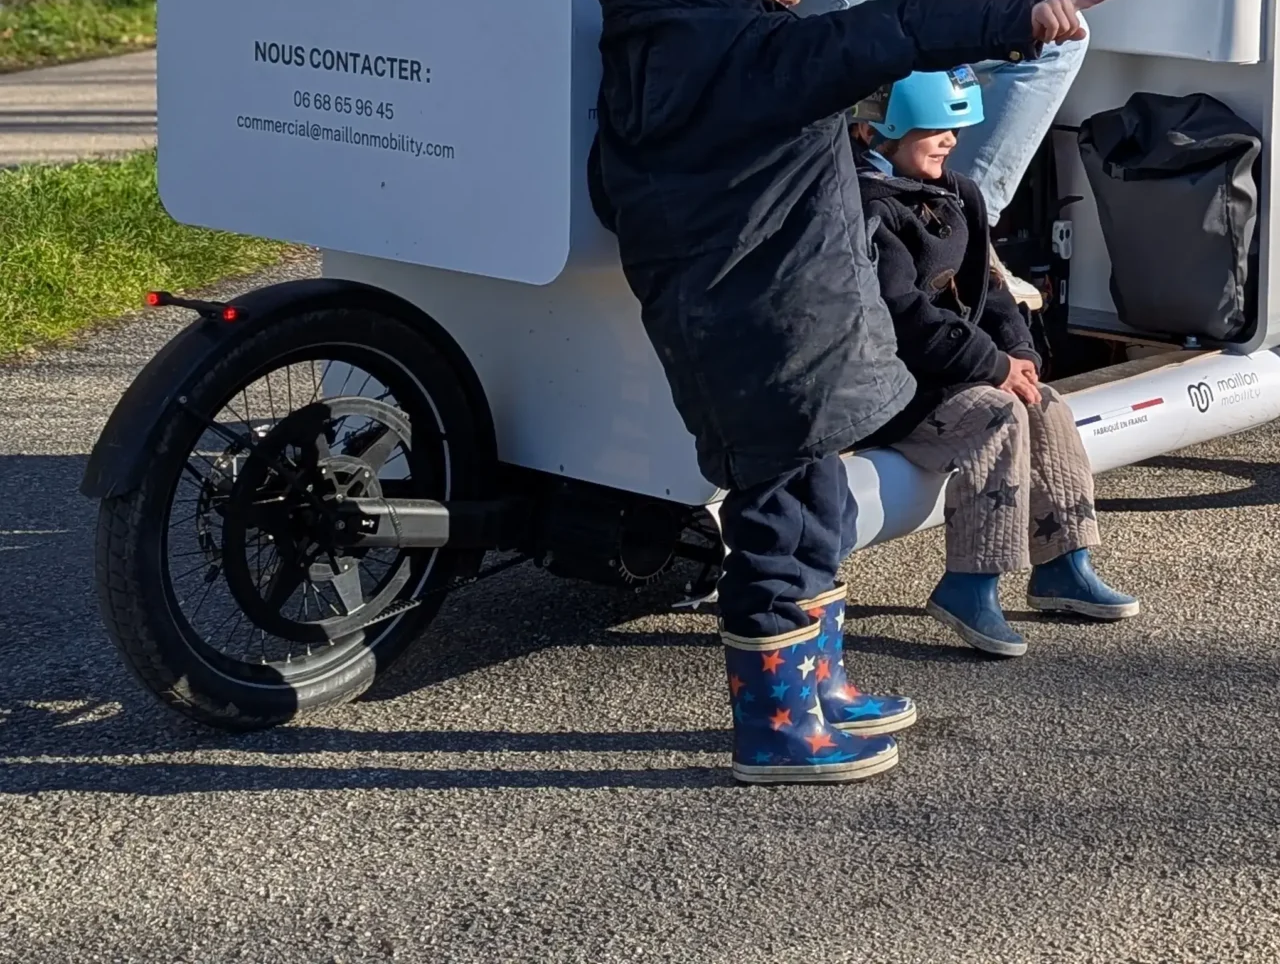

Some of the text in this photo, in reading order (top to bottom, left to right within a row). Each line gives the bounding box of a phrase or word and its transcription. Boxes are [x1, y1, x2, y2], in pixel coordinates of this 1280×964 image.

[254, 40, 305, 67] NOUS
[309, 47, 422, 83] CONTACTER
[293, 90, 394, 120] 06 68 65 96 45
[236, 114, 455, 159] commercial@maillonmobility.com
[1217, 372, 1259, 392] maillon
